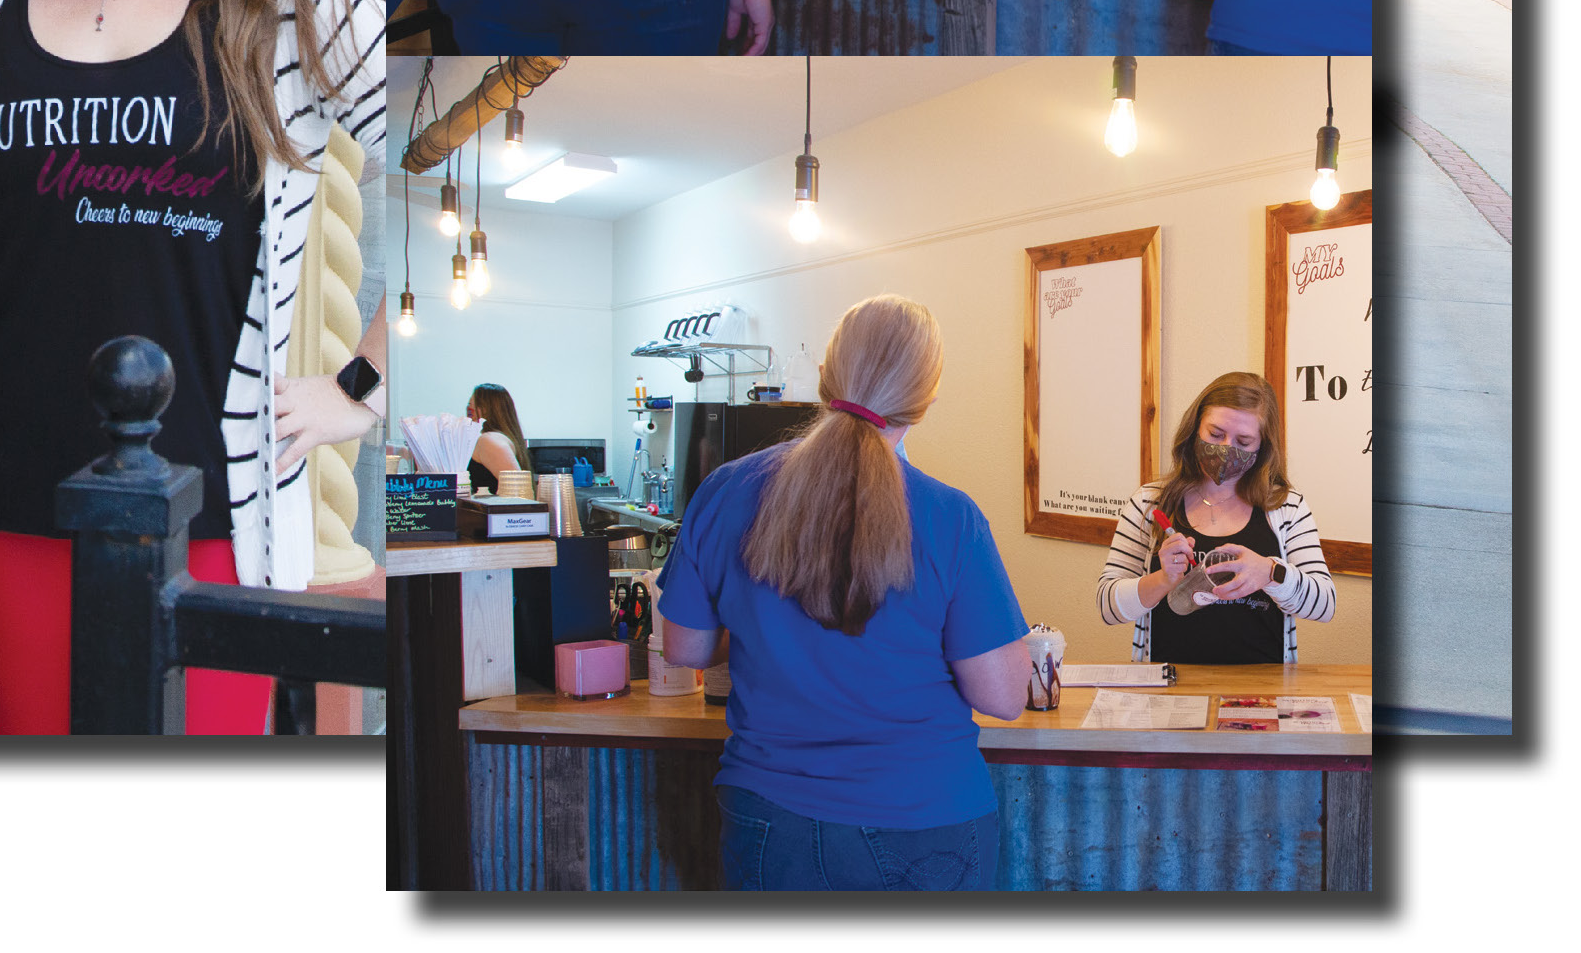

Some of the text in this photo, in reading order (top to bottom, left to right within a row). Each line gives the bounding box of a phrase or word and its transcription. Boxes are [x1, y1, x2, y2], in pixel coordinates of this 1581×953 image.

[37, 148, 228, 201] Uncorked
[75, 196, 223, 242] Cheers to new beginnings
[1303, 243, 1338, 264] MY
[1292, 256, 1345, 295] Goals
[1296, 364, 1348, 402] To
[416, 476, 449, 489] Menu
[1044, 499, 1062, 508] What
[1089, 506, 1117, 516] waiting
[1059, 490, 1071, 499] It's
[1071, 493, 1087, 501] your
[1088, 494, 1108, 505] blank
